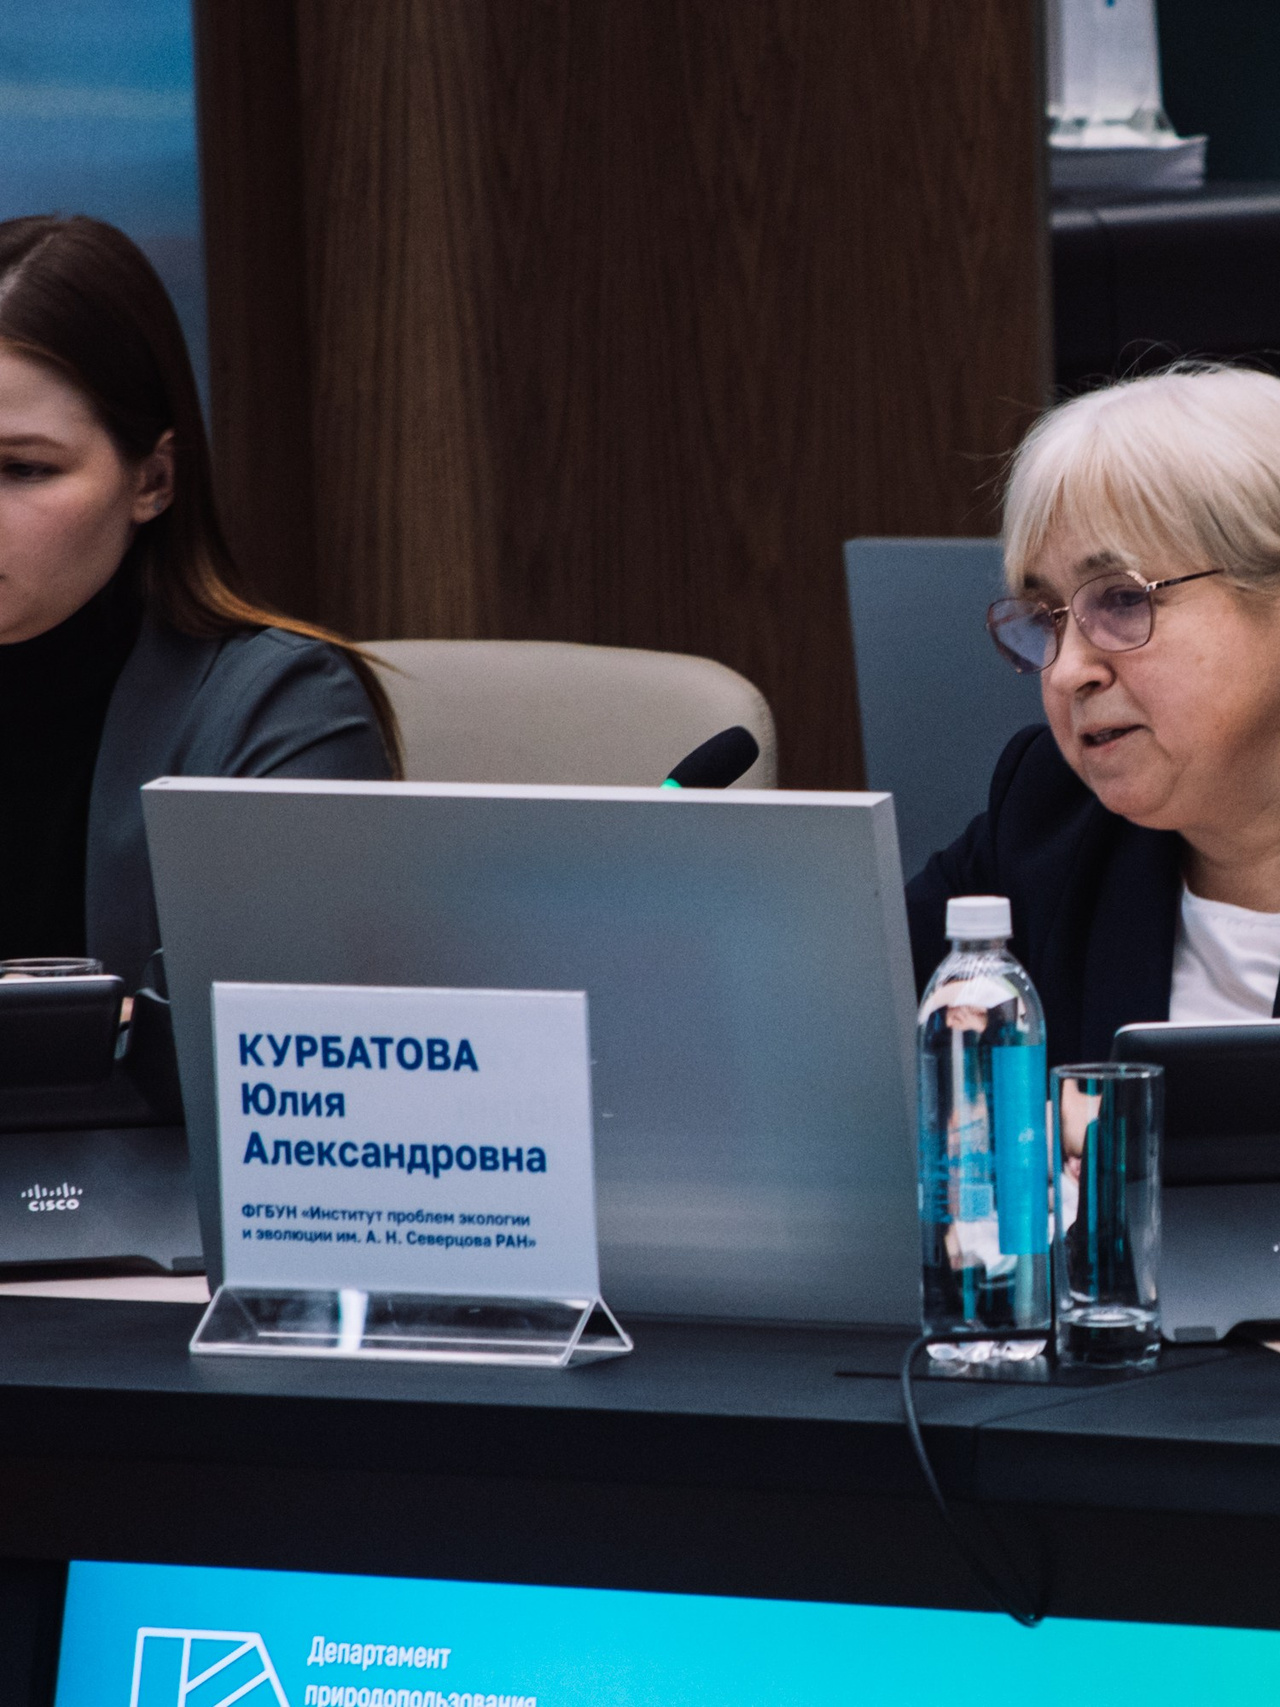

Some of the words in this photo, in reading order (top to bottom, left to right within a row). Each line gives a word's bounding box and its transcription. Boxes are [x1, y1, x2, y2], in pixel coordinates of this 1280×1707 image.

[239, 1033, 479, 1072] КУРБАТОВА
[241, 1082, 346, 1117] Юлия
[243, 1131, 547, 1178] Александровна
[241, 1204, 298, 1219] ФГБУН
[301, 1206, 383, 1224] «Институт
[387, 1209, 455, 1225] проблем
[459, 1214, 531, 1227] экологии
[242, 1229, 252, 1240] и
[256, 1230, 333, 1244] эволюции
[336, 1232, 362, 1243] им.
[366, 1231, 382, 1244] А.
[386, 1232, 402, 1245] Н.
[406, 1231, 492, 1249] Северцова
[495, 1233, 537, 1249] РАН»
[307, 1635, 452, 1671] Департамент
